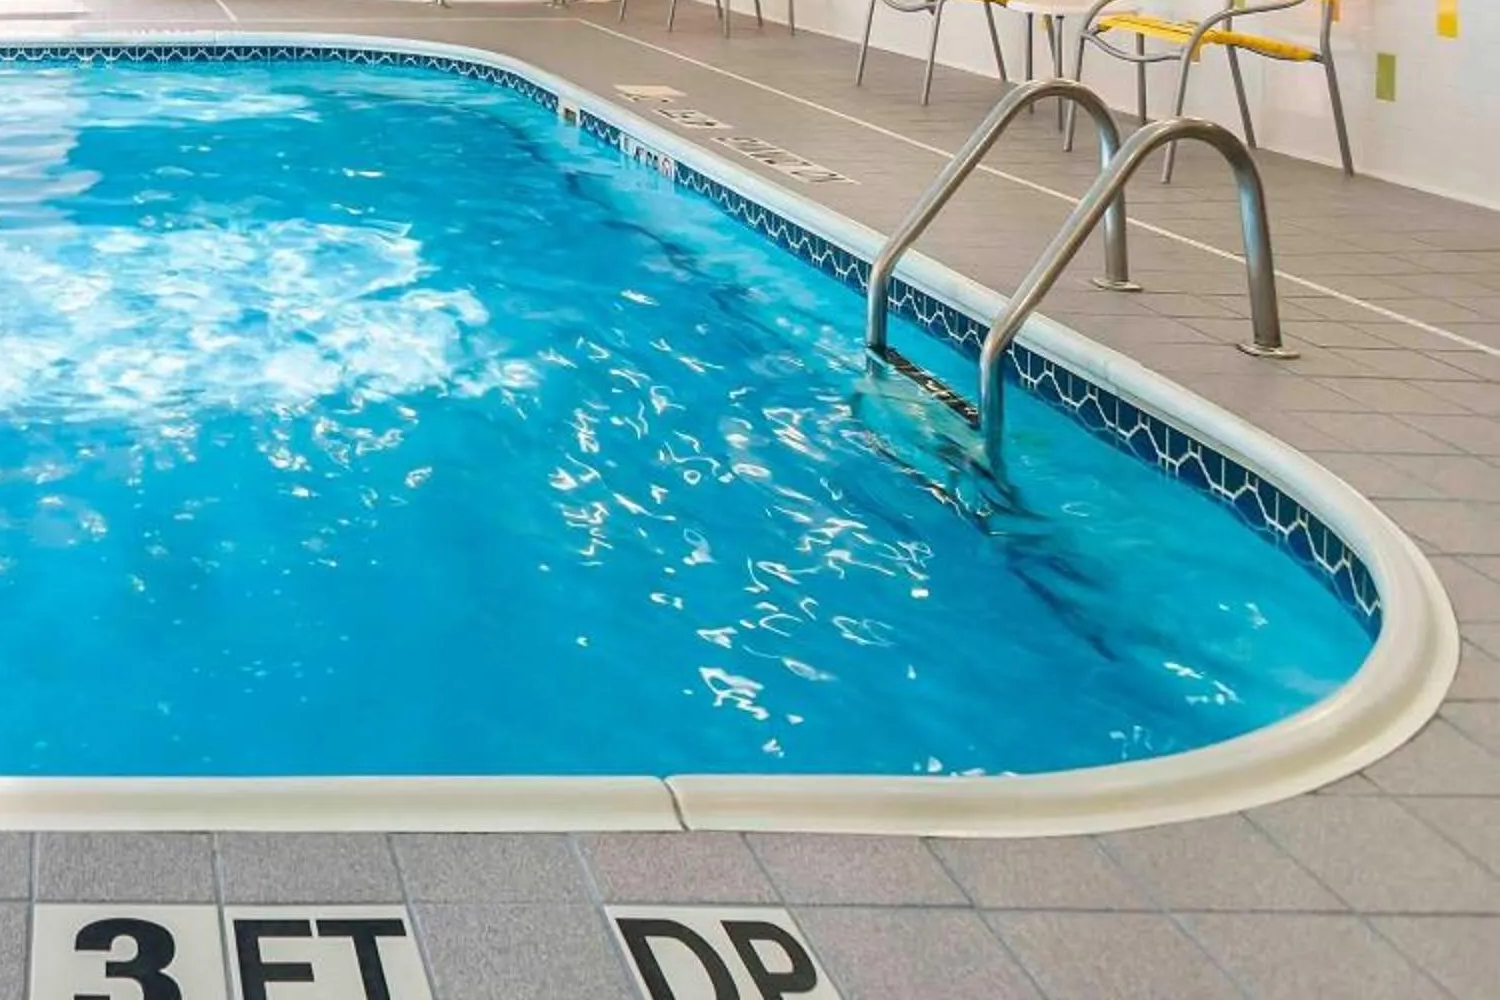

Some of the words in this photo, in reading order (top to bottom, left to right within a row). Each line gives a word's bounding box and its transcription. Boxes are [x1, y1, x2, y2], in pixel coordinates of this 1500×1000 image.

[73, 917, 183, 1000] 3
[233, 918, 407, 1000] FT
[615, 917, 818, 1000] DP
